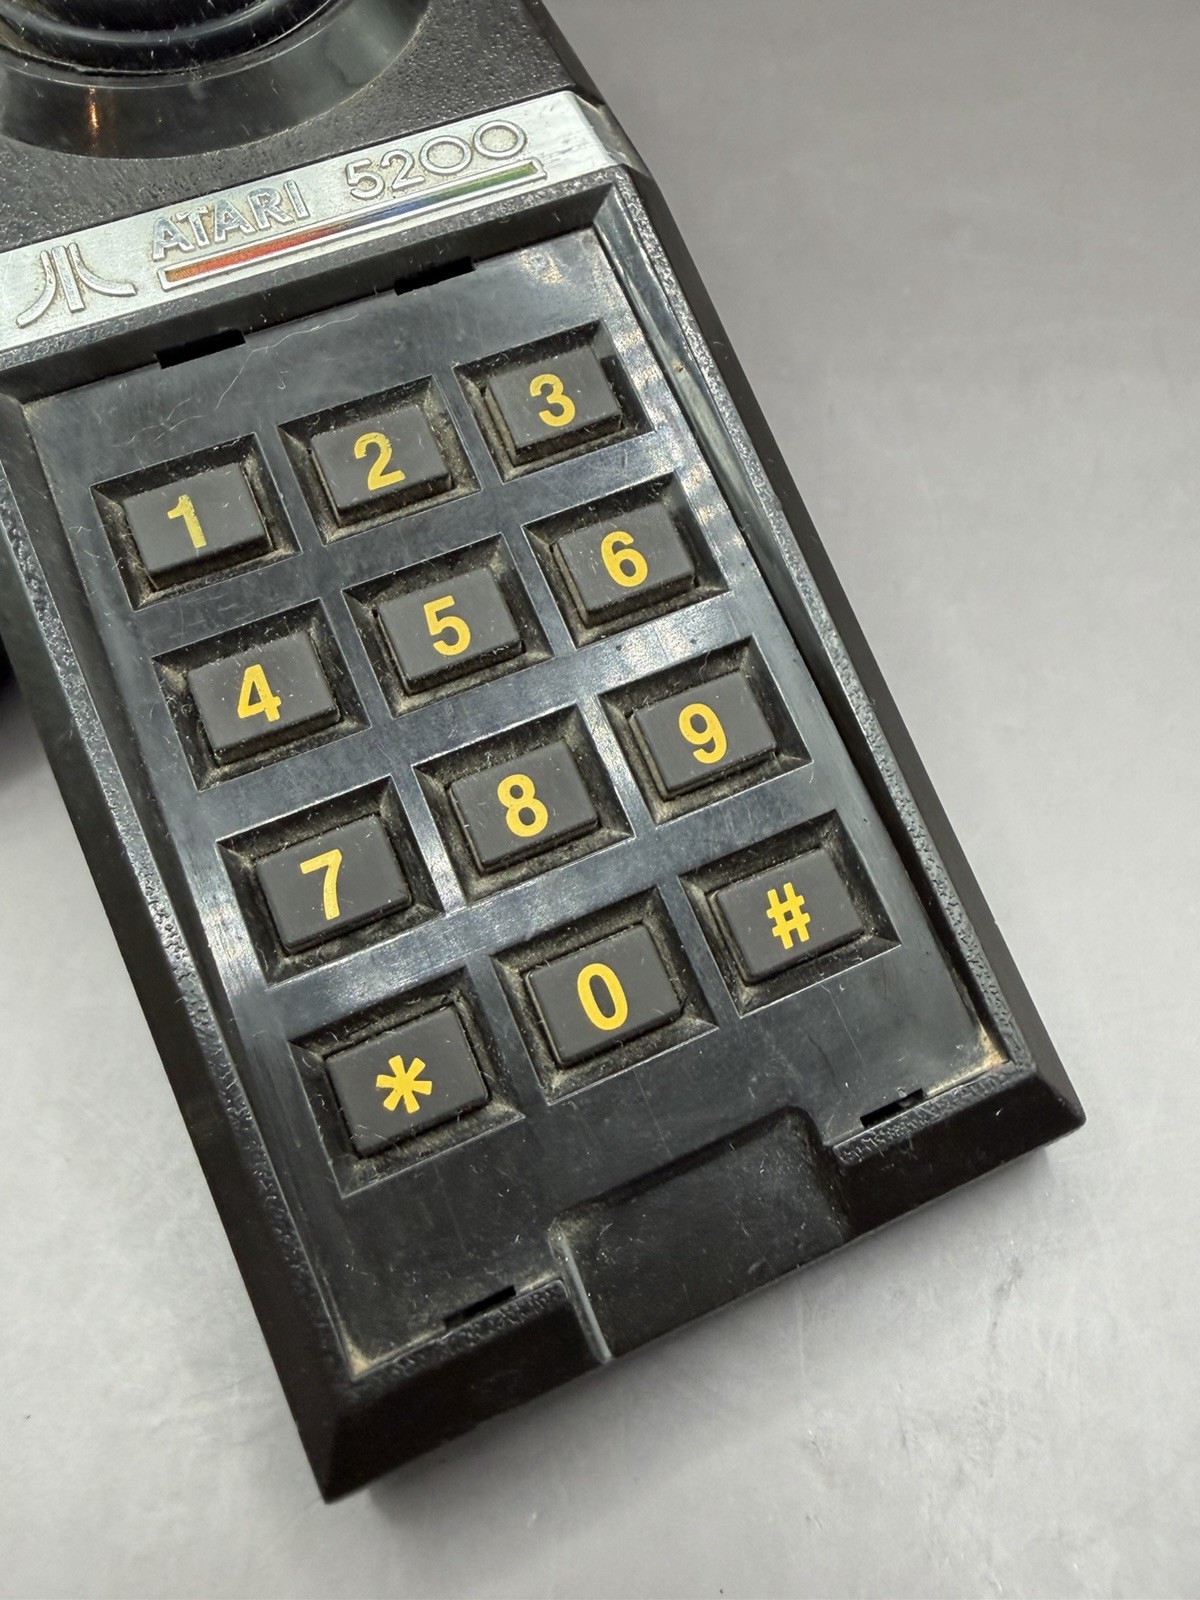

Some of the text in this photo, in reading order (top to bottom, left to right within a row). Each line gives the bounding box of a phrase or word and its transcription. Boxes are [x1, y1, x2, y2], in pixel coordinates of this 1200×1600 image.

[152, 120, 527, 261] ATARI 5200
[528, 372, 576, 428] 3
[353, 431, 405, 490] 2
[166, 494, 206, 549] 1
[599, 529, 648, 588] 6
[423, 594, 472, 657] 5
[235, 662, 281, 722] 4
[676, 701, 727, 764] 9
[497, 772, 549, 838] 8
[300, 848, 341, 921] 7
[765, 880, 811, 949] #
[575, 961, 628, 1032] 0
